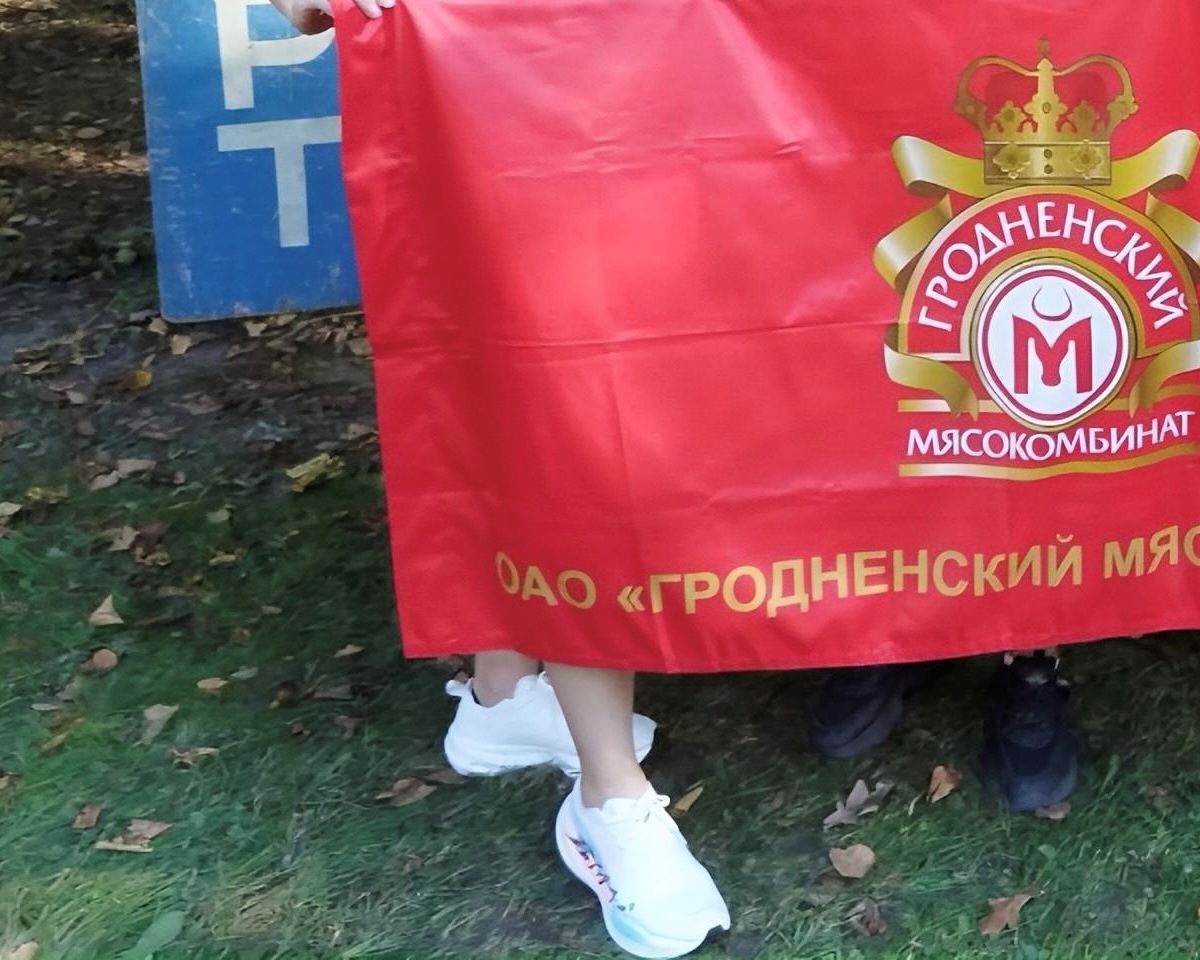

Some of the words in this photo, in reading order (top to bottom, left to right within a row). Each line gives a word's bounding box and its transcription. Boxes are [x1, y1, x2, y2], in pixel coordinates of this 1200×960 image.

[917, 201, 1189, 332] ГРОДНЕНСКИЙ
[906, 410, 1196, 462] МЯСОКОМБИНАТ
[495, 551, 598, 610] ОАО
[616, 533, 1082, 618] «ГРОДНЕНСКИЙ
